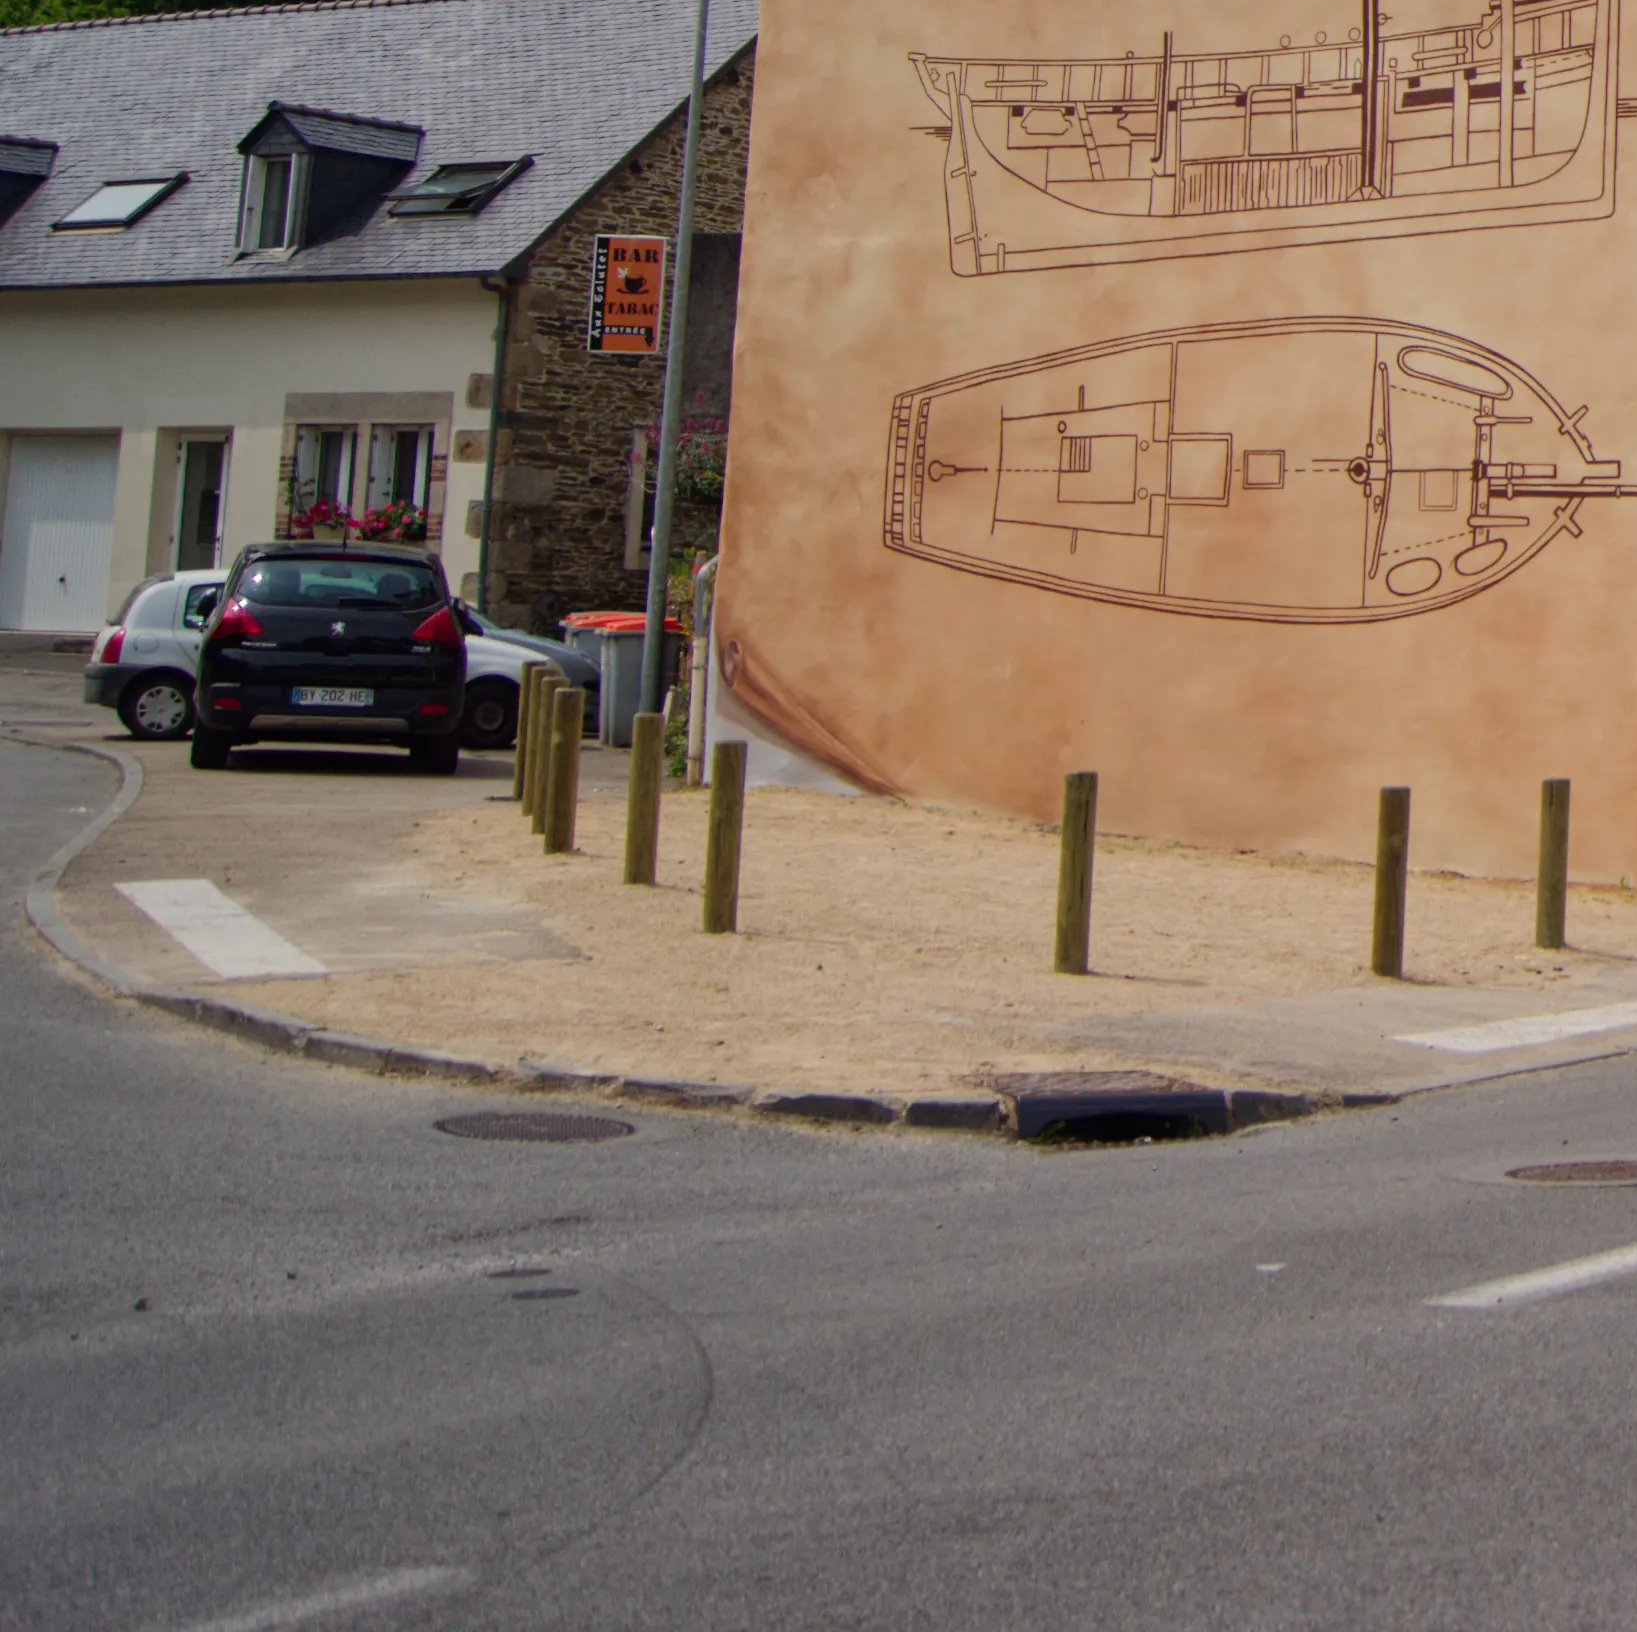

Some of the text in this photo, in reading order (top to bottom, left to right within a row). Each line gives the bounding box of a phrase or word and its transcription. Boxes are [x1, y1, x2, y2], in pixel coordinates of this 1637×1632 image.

[613, 248, 659, 263] BAR
[606, 302, 659, 316] TABAC
[300, 689, 315, 701] BY
[321, 690, 344, 702] 202
